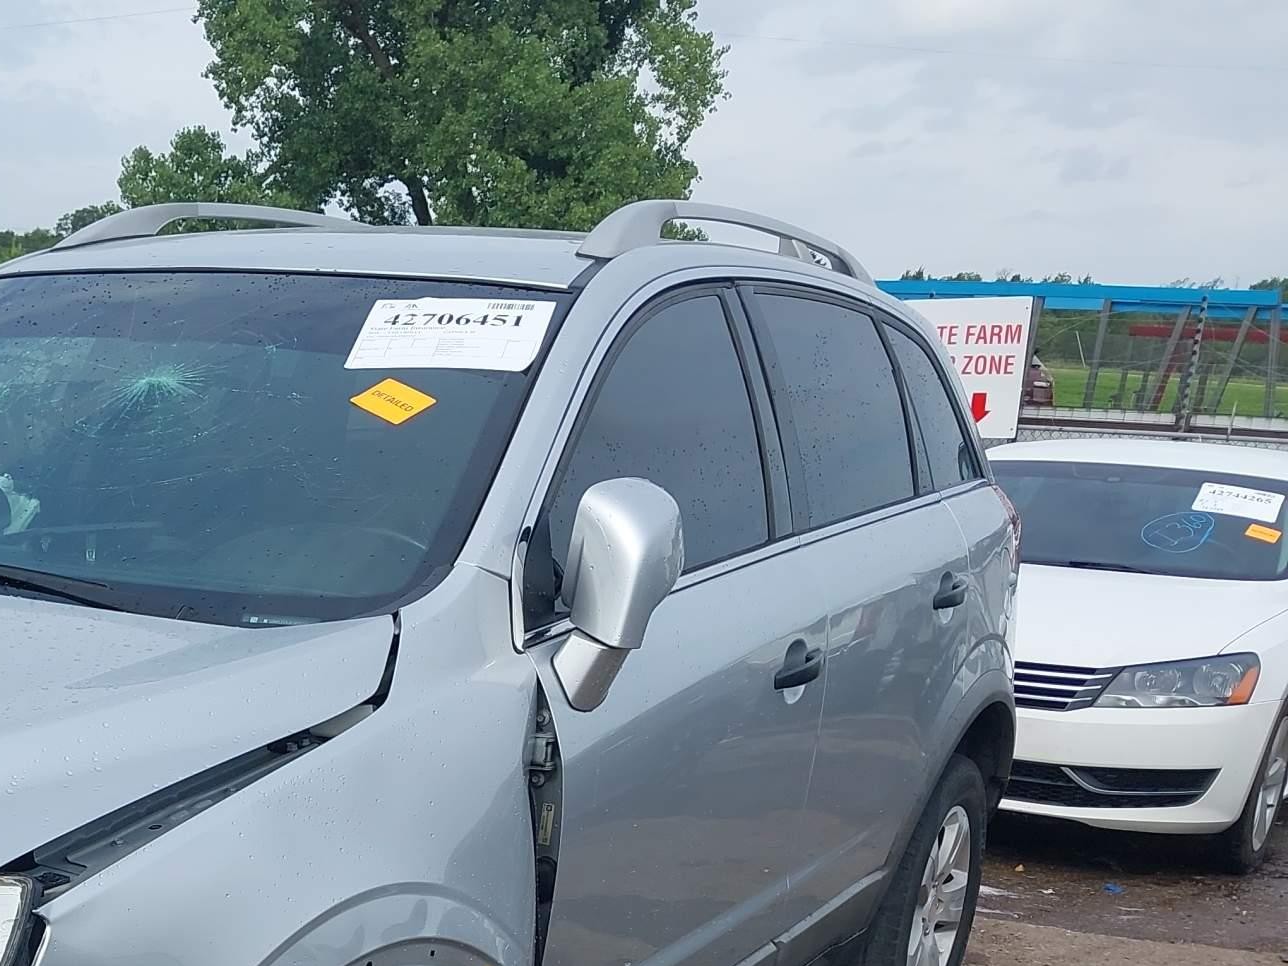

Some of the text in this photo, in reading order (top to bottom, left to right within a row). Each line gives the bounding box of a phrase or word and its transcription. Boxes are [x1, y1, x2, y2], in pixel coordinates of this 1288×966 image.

[384, 312, 523, 327] 42706451
[965, 324, 1023, 345] FARM
[961, 355, 1015, 375] ZONE
[371, 389, 415, 412] DETAILED
